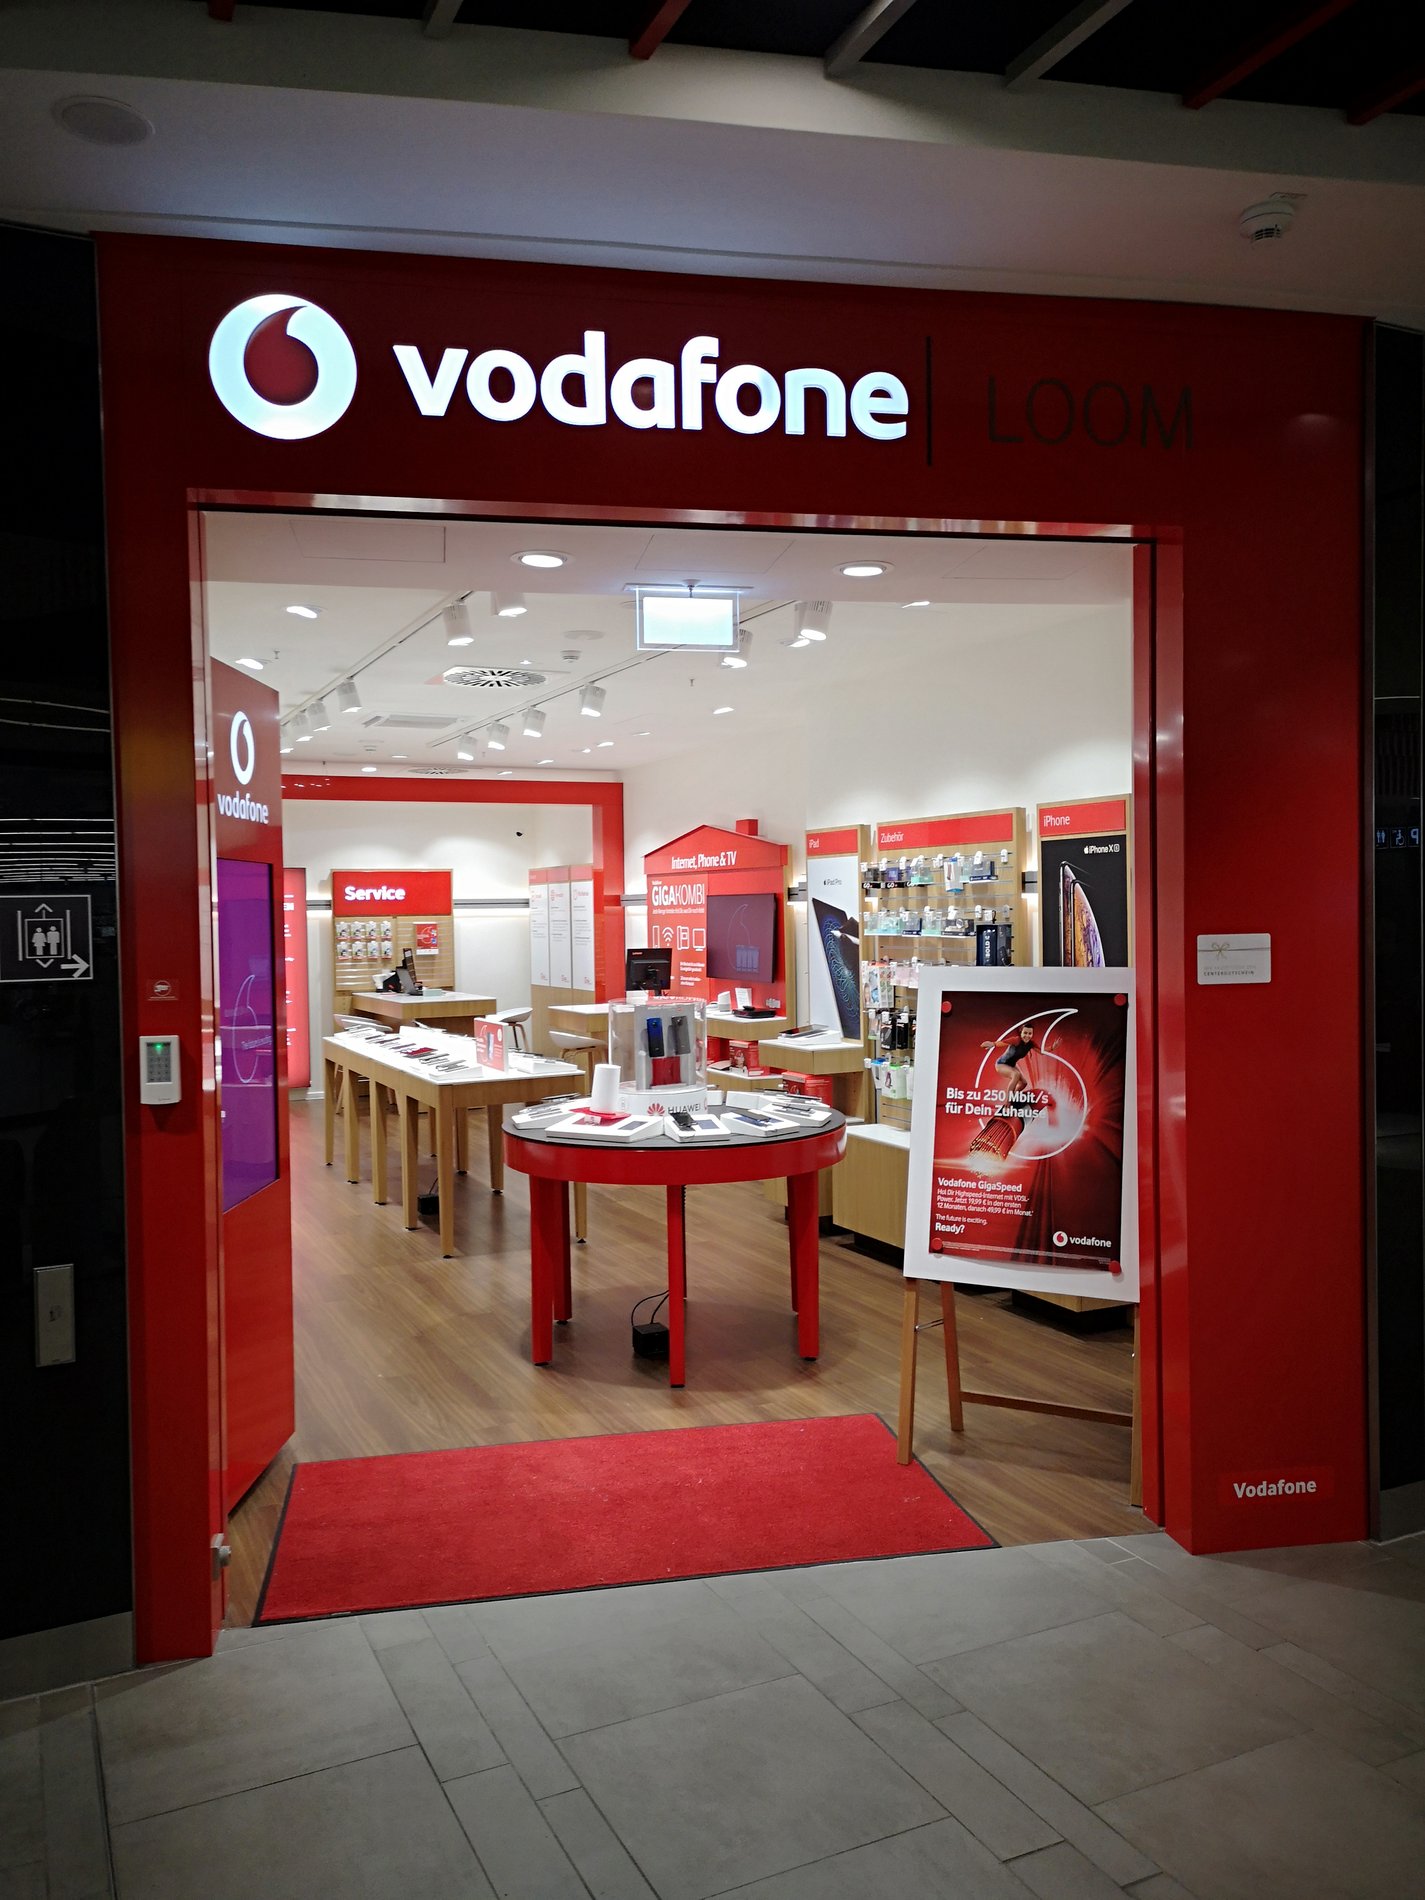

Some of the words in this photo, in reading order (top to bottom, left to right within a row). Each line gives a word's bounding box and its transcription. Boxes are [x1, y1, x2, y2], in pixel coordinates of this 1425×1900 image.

[393, 330, 909, 440] vodafone
[988, 376, 1192, 449] LOOM
[217, 791, 269, 824] vodafone
[1044, 814, 1070, 827] iPhone
[809, 838, 820, 848] iPad
[880, 832, 904, 843] Zubehör
[1089, 846, 1108, 854] iPhone
[672, 856, 697, 869] Internet,
[698, 854, 719, 868] Phone
[720, 852, 726, 866] &
[726, 851, 737, 866] TV
[344, 885, 406, 900] Service
[652, 884, 704, 906] GIGAKOMBI
[947, 1088, 964, 1099] Bis
[966, 1091, 980, 1100] zu
[984, 1090, 1005, 1101] 250
[668, 1104, 700, 1114] HUAWEI
[945, 1102, 963, 1114] für
[965, 1103, 991, 1115] Dein
[994, 1106, 1046, 1118] Zuhause
[938, 1178, 976, 1188] Vodafone
[978, 1181, 1022, 1192] GigaSpeed
[935, 1222, 965, 1234] Ready?
[1069, 1236, 1112, 1247] vodafone
[1233, 1479, 1316, 1498] Vodafone
